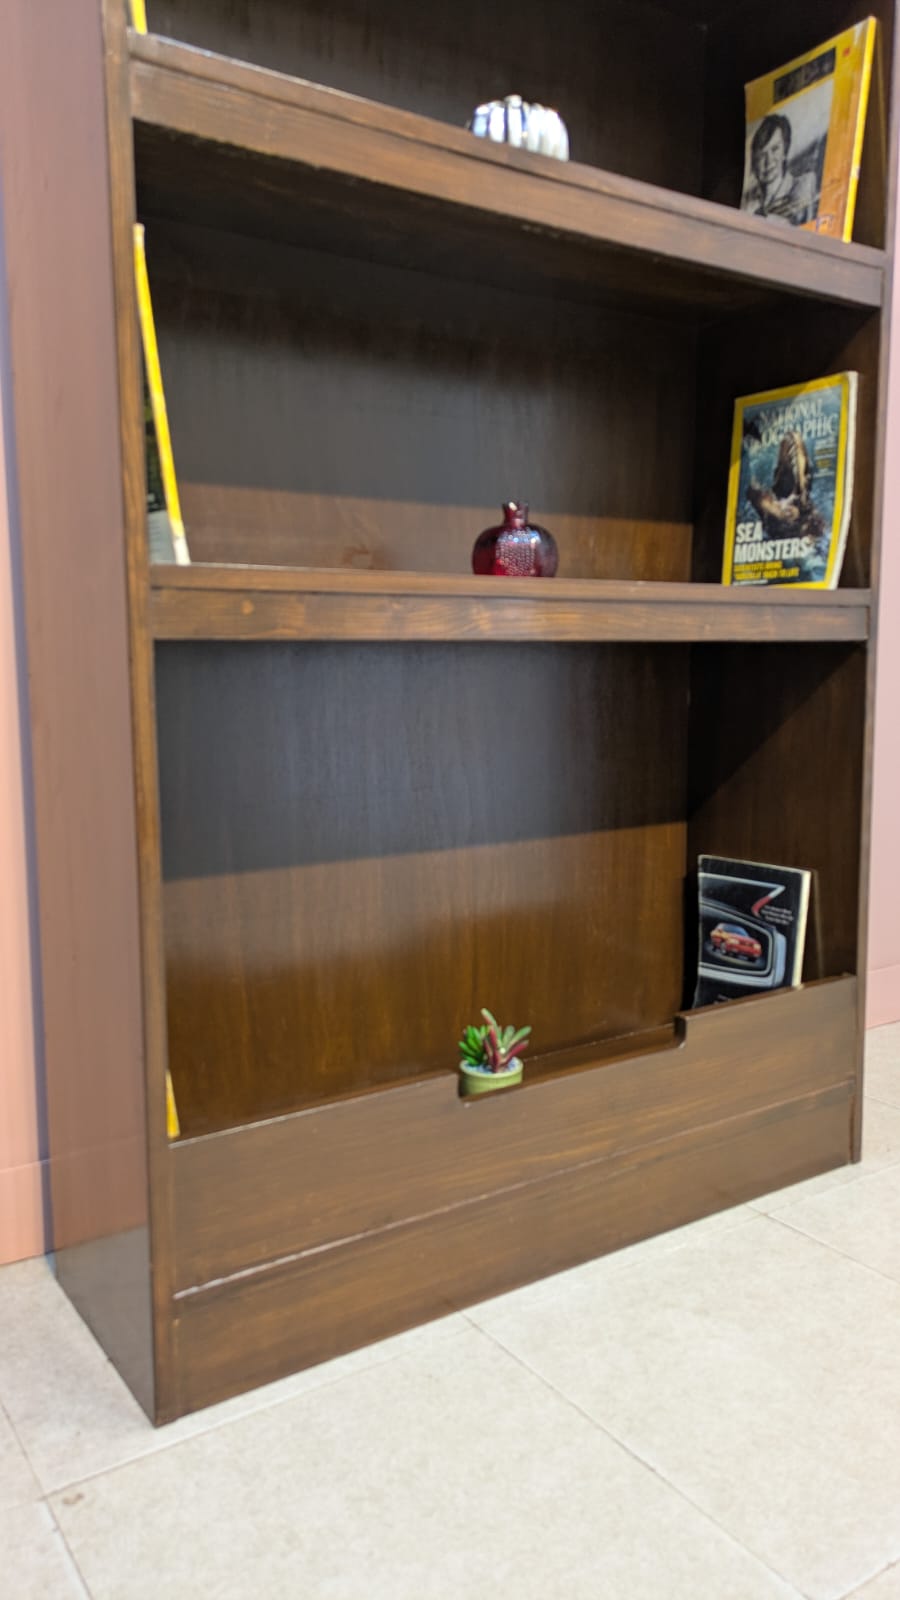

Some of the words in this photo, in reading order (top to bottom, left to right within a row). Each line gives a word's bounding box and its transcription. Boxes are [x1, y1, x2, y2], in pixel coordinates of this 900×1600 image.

[759, 398, 823, 428] NATIONAL
[736, 520, 763, 543] SEA
[734, 537, 809, 563] MONSTERS
